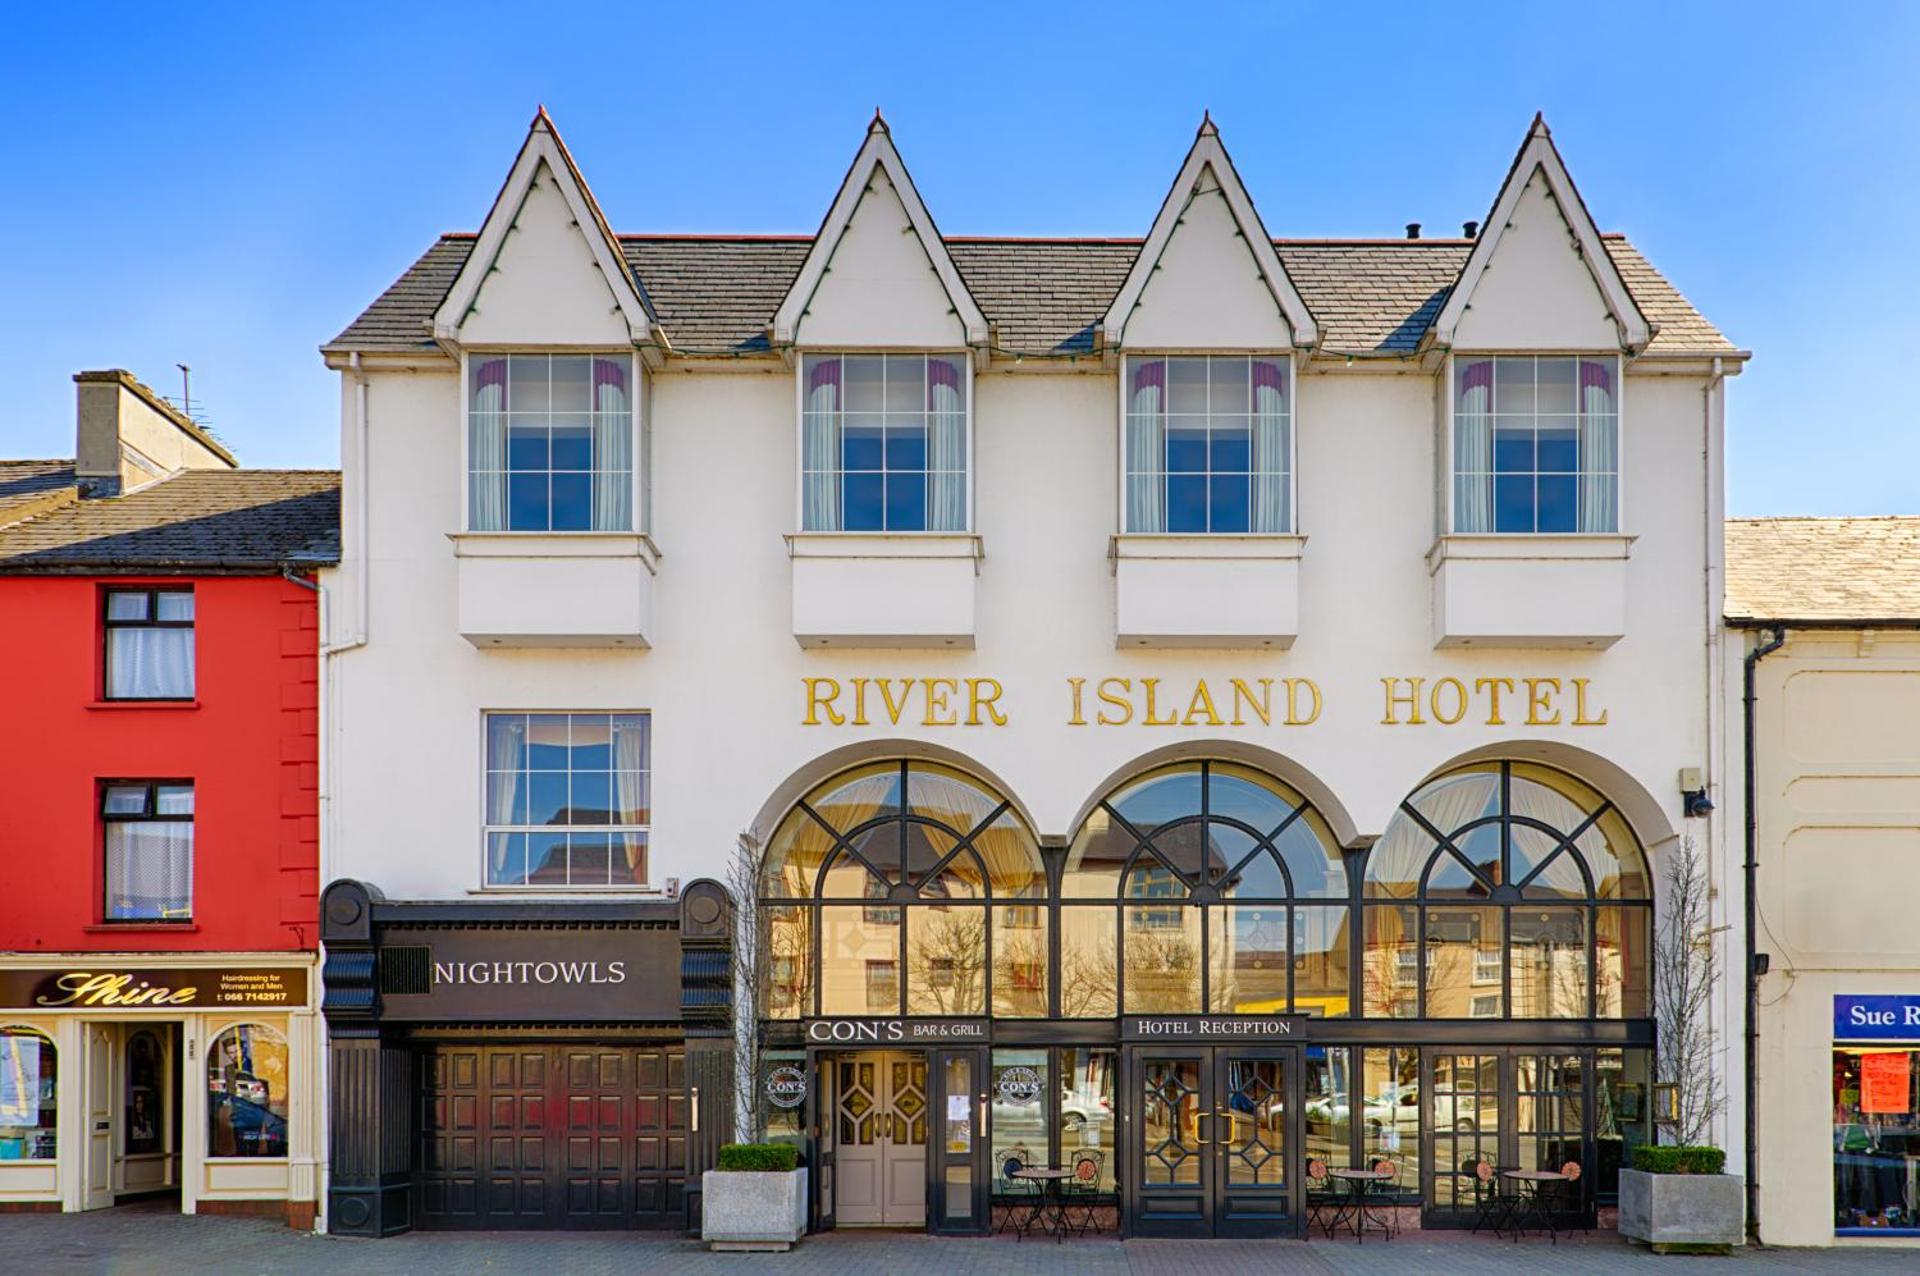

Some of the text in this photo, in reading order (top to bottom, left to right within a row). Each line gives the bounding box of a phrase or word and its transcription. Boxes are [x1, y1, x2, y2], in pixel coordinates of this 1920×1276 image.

[803, 677, 1606, 727] RIVER ISLAND HOTEL
[222, 974, 268, 982] Hairdressing
[433, 961, 626, 984] NIGHTOWLS
[36, 973, 198, 1006] Shine
[224, 992, 243, 1000] 066
[245, 992, 287, 1000] 7142917
[1850, 1005, 1896, 1026] Sue
[809, 1020, 984, 1041] CON'S BAR & GRILL
[1138, 1020, 1291, 1034] HOTEL RECEPTION
[1000, 1082, 1040, 1093] CON'S
